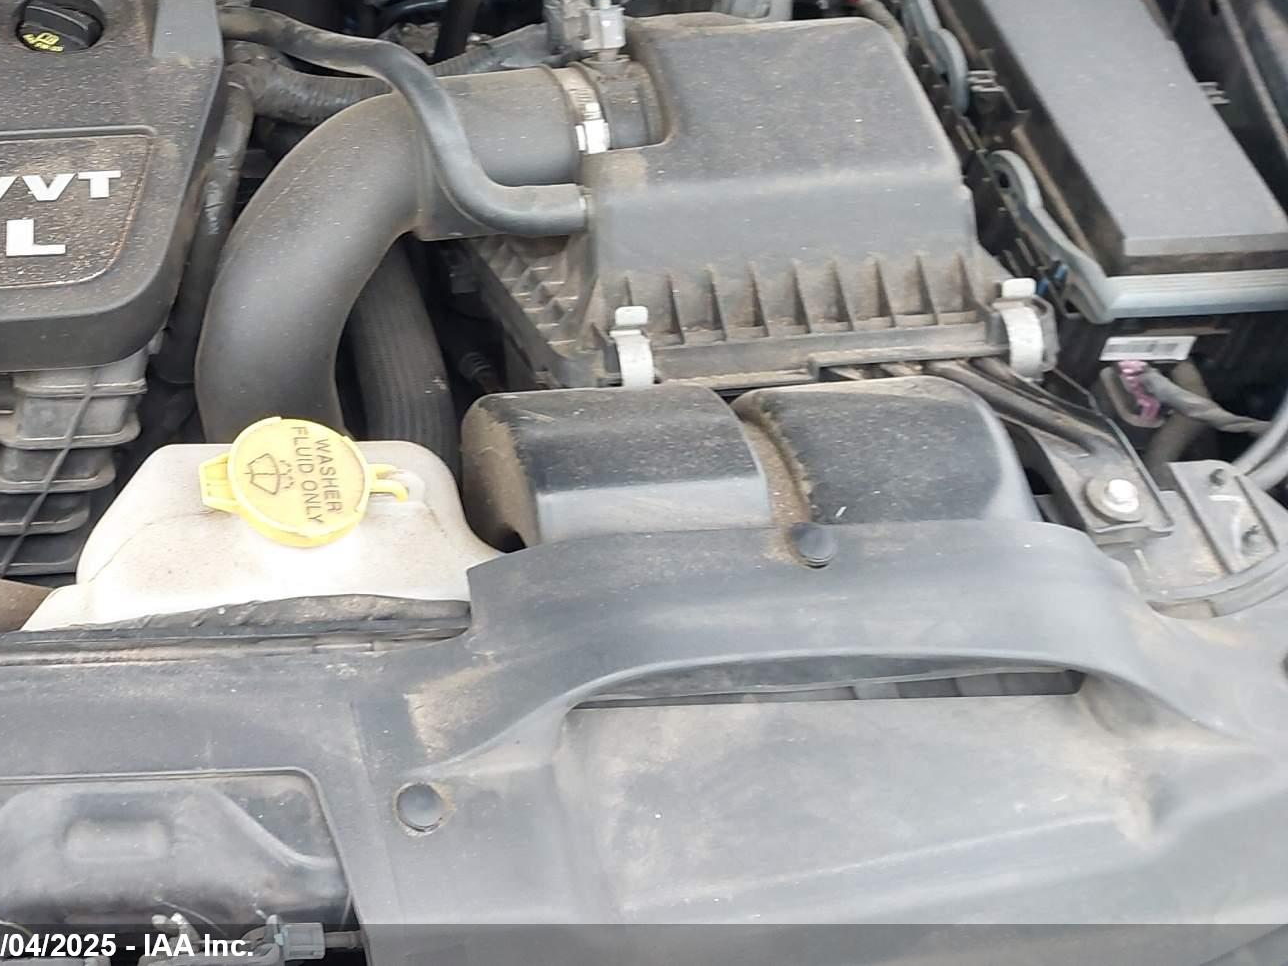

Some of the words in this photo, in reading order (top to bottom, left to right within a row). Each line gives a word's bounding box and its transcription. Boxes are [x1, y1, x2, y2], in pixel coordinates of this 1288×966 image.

[292, 426, 315, 475] FLUID
[314, 438, 344, 514] WASHER
[300, 480, 324, 525] ONLY
